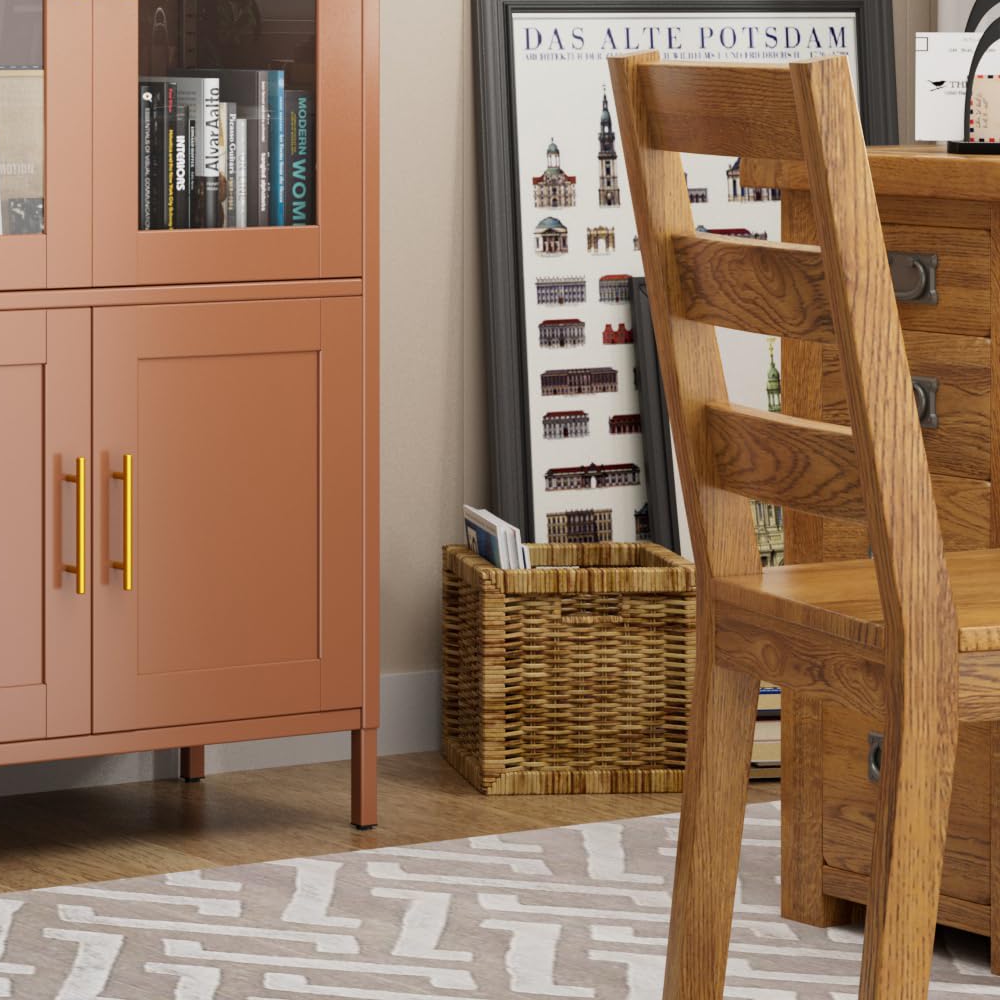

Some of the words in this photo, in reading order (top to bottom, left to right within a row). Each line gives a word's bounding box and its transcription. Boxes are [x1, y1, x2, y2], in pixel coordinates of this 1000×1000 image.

[523, 26, 585, 51] DAS
[601, 26, 682, 50] ALTE
[698, 25, 848, 49] POTSDAM
[950, 80, 967, 89] TH
[205, 87, 219, 129] Aalto
[298, 97, 307, 156] MODERN
[175, 135, 186, 192] INTERIORS
[205, 131, 219, 171] Alvar
